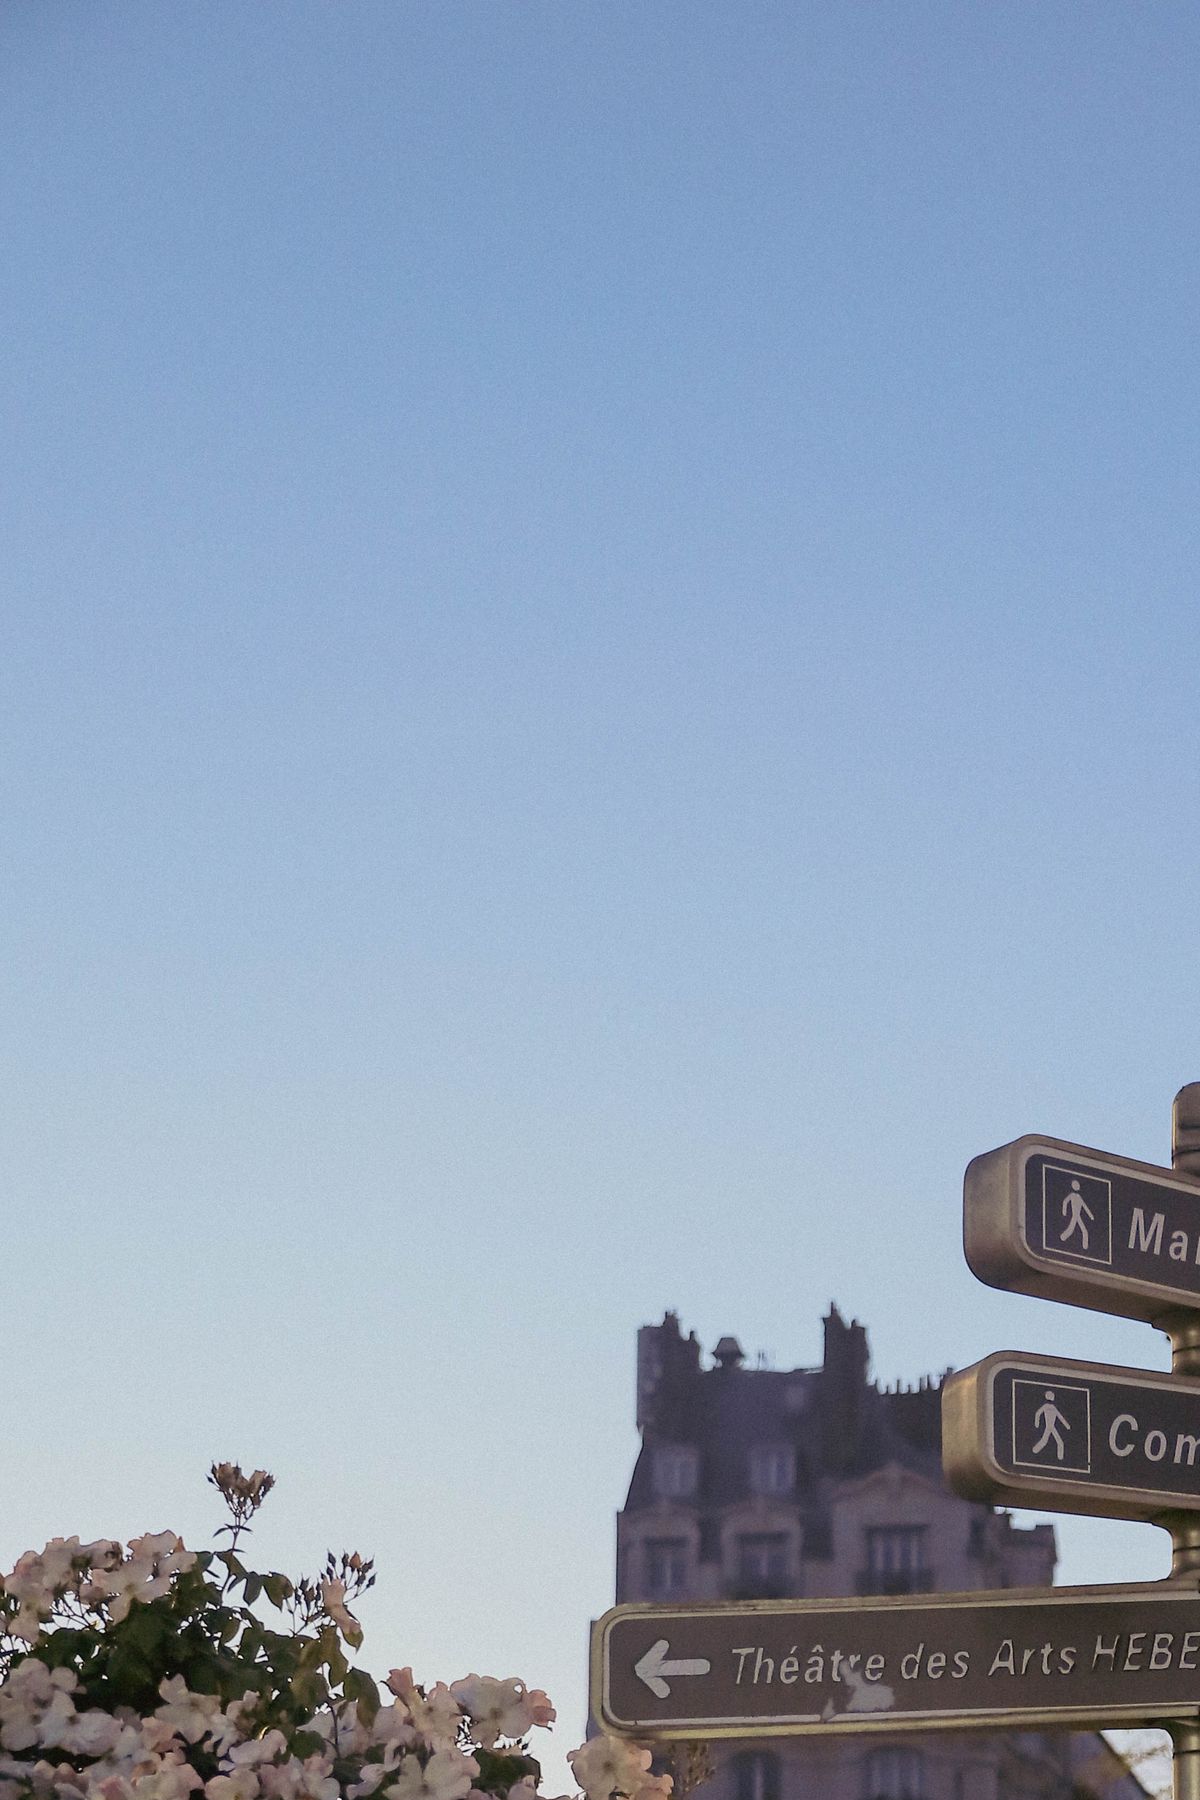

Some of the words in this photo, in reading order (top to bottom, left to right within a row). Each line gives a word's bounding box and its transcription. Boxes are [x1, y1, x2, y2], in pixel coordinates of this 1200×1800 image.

[731, 1644, 885, 1684] Théâtre
[900, 1642, 970, 1680] des
[988, 1639, 1077, 1677] Arts
